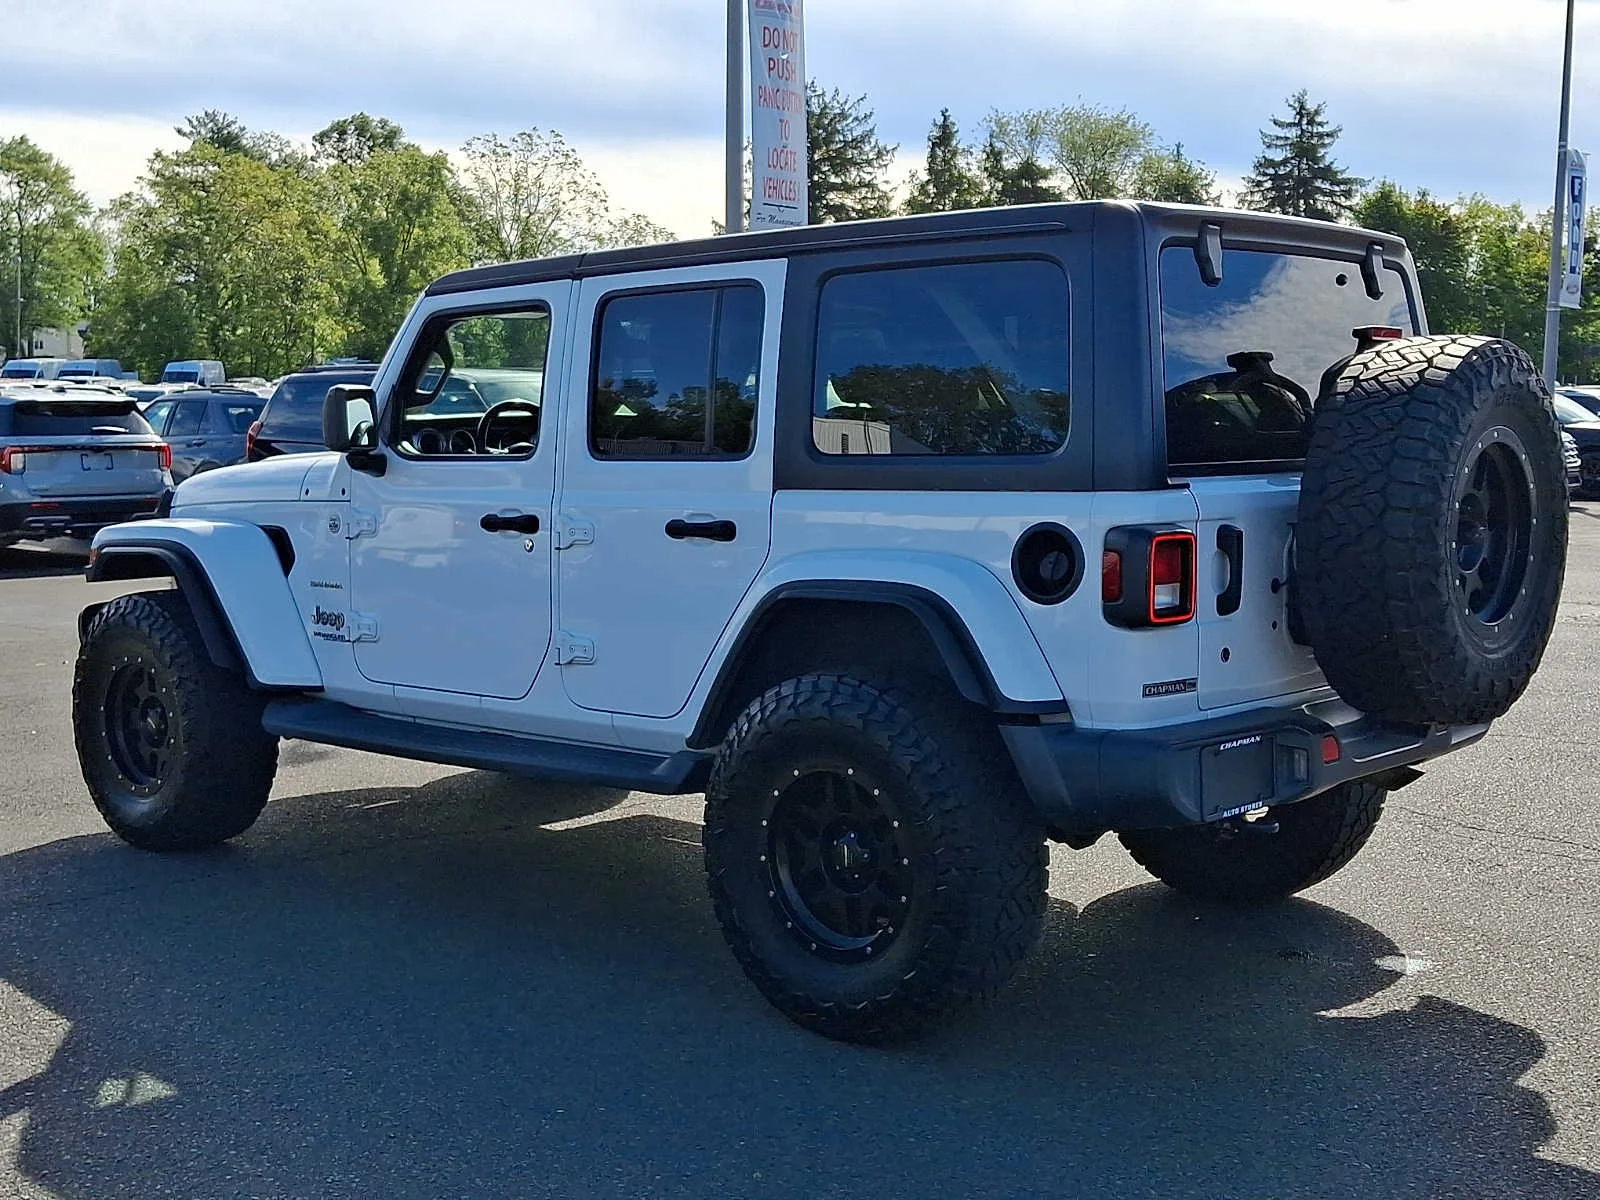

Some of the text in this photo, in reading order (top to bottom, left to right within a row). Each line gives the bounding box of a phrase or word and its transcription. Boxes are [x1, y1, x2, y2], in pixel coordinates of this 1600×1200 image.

[763, 26, 798, 52] DO NOT
[768, 57, 796, 82] PUSH
[758, 85, 780, 110] PANIC
[779, 118, 790, 141] TO
[767, 146, 797, 172] LOCATE
[312, 605, 345, 631] Jeep
[1145, 681, 1186, 695] CHAPMAN
[1220, 735, 1262, 750] CHAPMAN
[1223, 807, 1240, 818] AUTO
